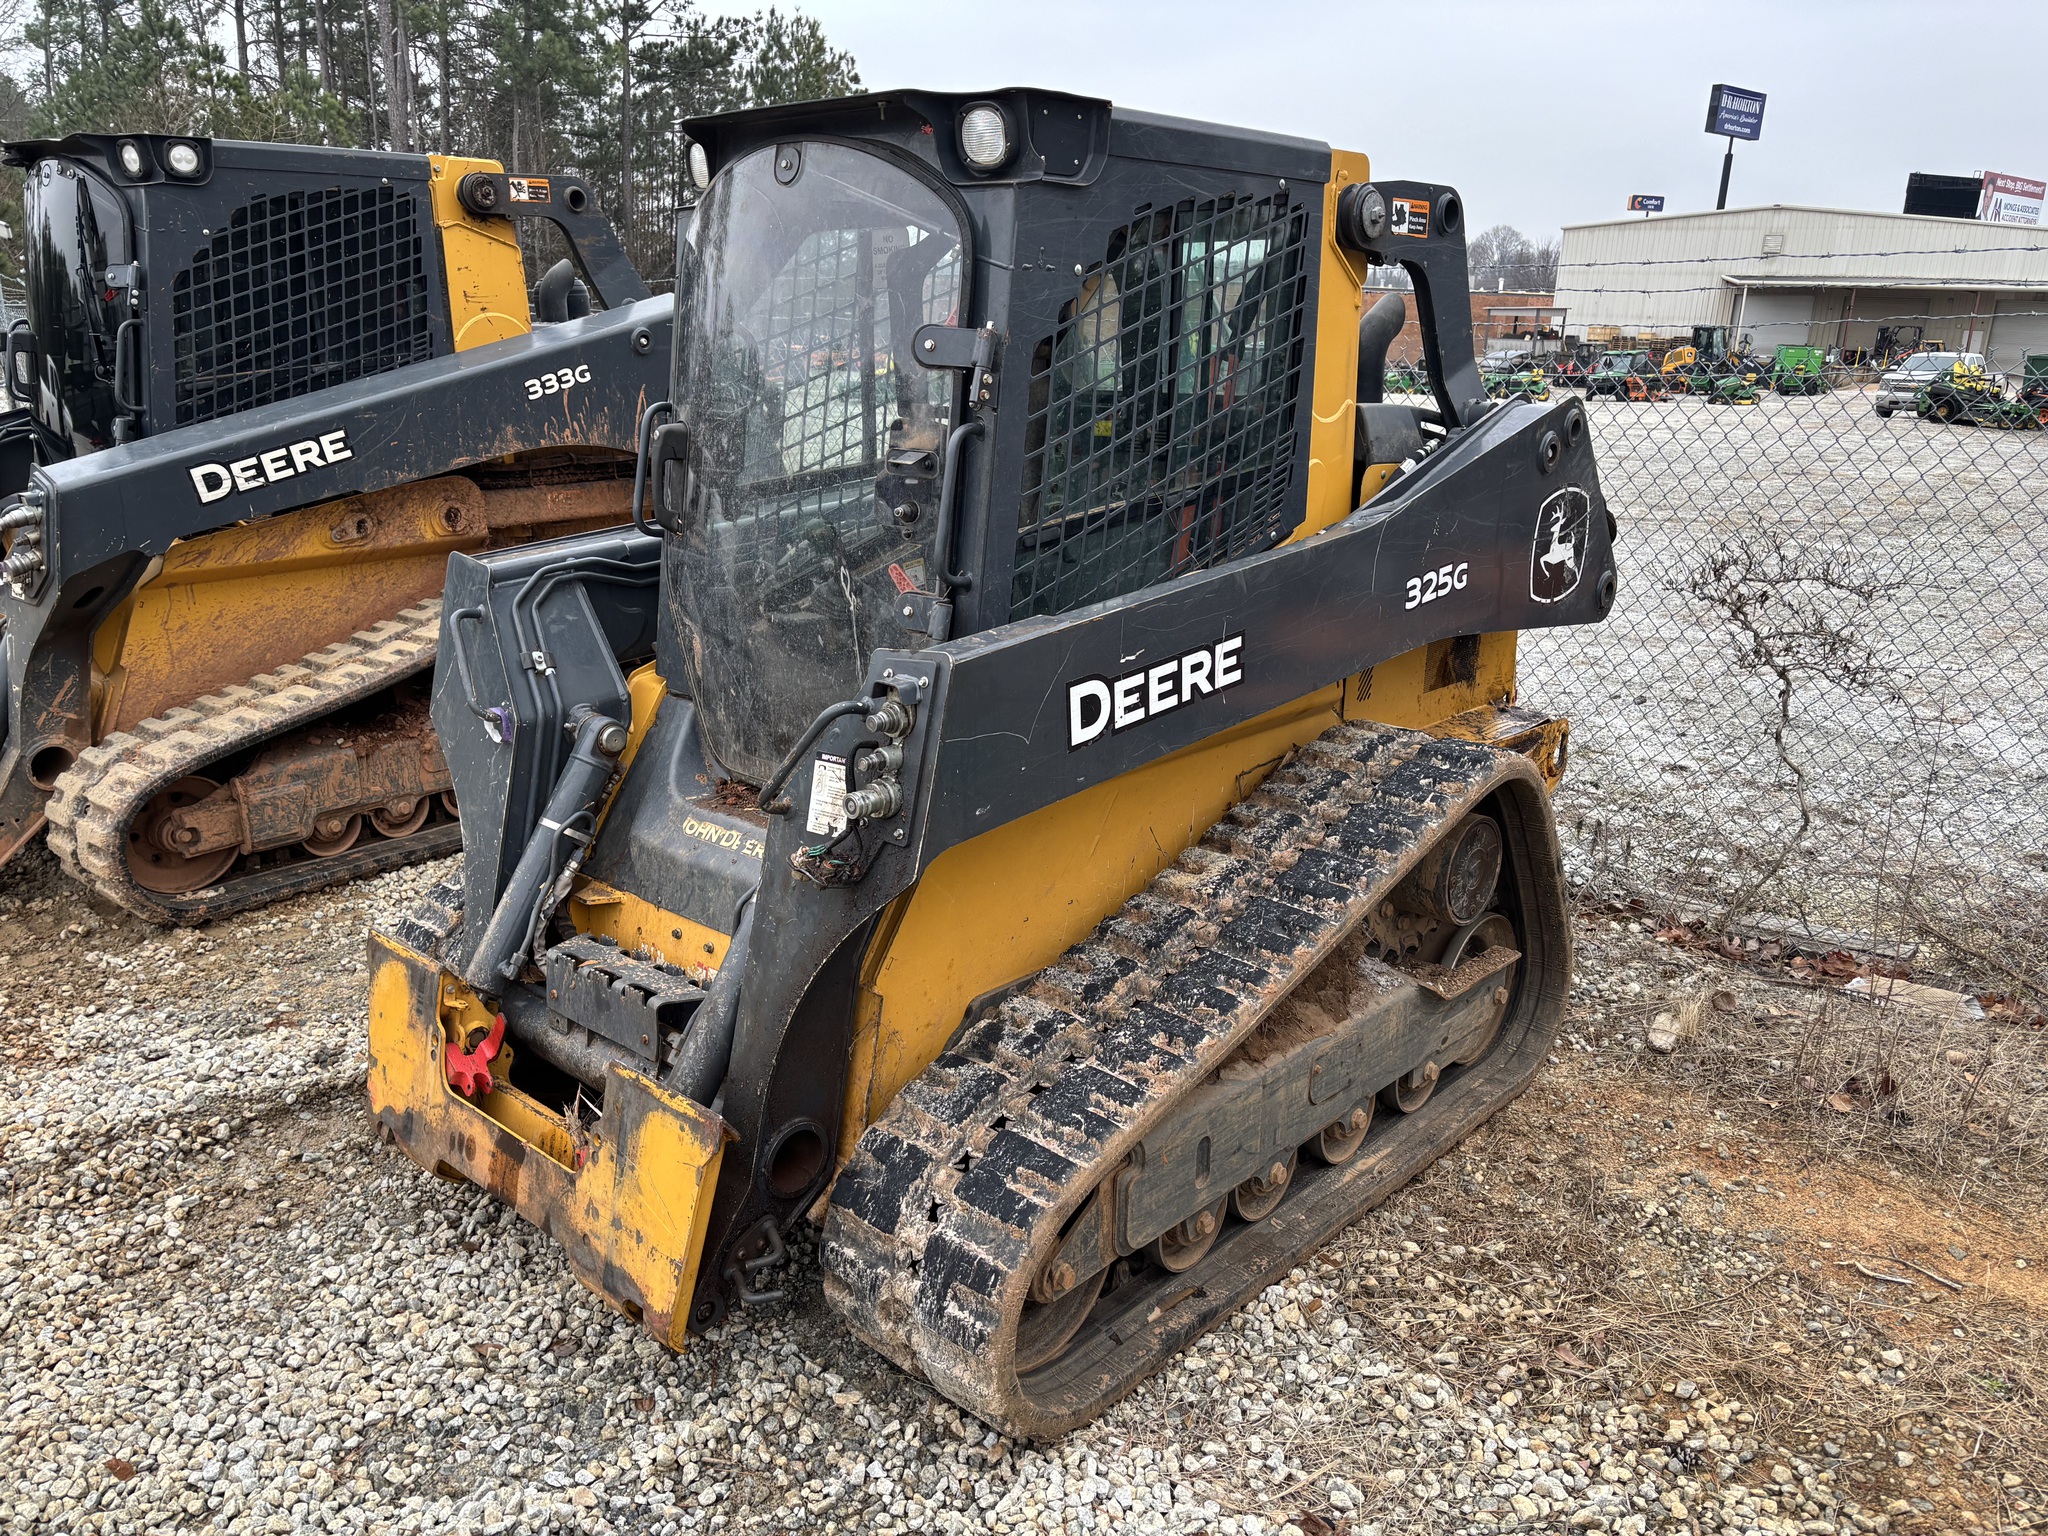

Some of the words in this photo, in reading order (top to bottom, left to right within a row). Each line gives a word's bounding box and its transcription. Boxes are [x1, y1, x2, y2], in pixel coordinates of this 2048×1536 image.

[1719, 110, 1739, 120] America's
[1739, 114, 1758, 123] Builder
[1724, 123, 1750, 133] drhorton.com
[1996, 177, 2006, 187] Next
[882, 235, 894, 244] NO
[524, 364, 592, 401] 333G
[189, 430, 353, 504] DEERE
[1405, 562, 1469, 610] 325G
[1069, 635, 1243, 747] DEERE
